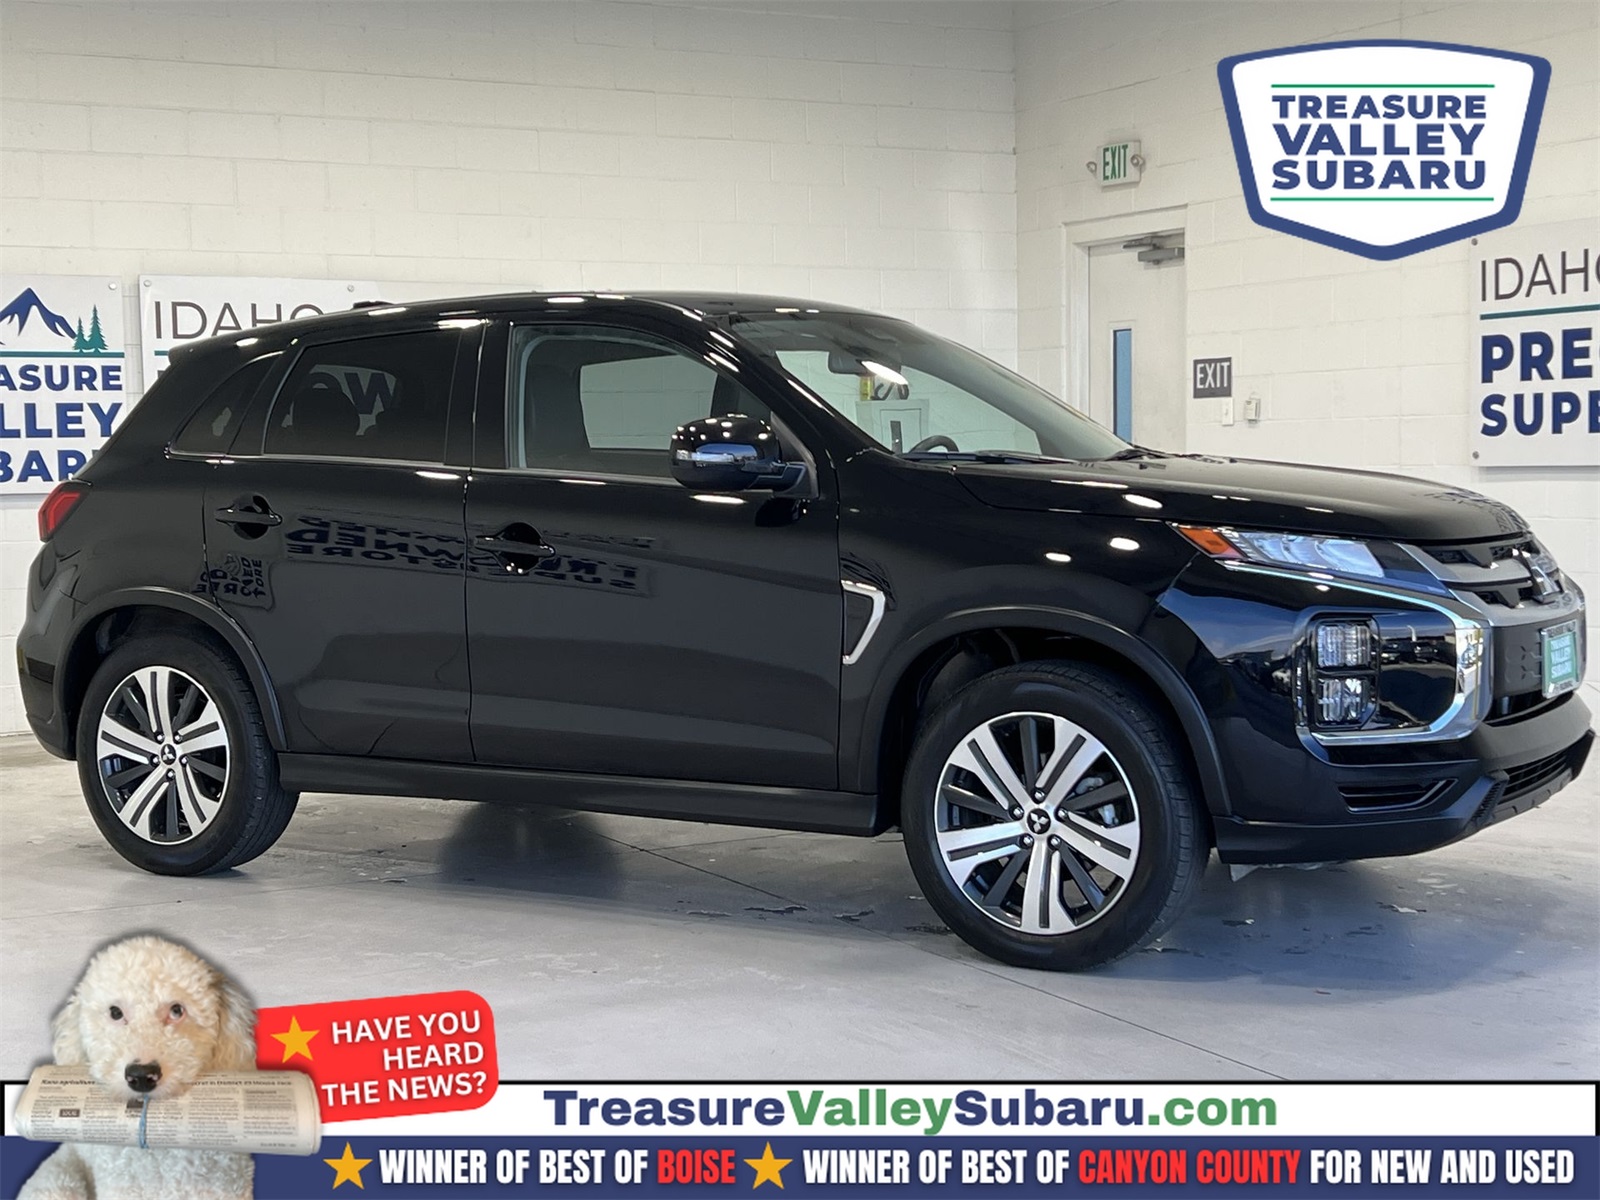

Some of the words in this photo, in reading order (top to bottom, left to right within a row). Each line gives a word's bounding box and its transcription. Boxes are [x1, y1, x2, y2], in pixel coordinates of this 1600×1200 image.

[1102, 144, 1129, 181] EXIT
[1480, 248, 1600, 302] IDAH
[1480, 327, 1600, 384] PRE
[0, 364, 123, 392] ASURE
[1196, 361, 1231, 389] EXIT
